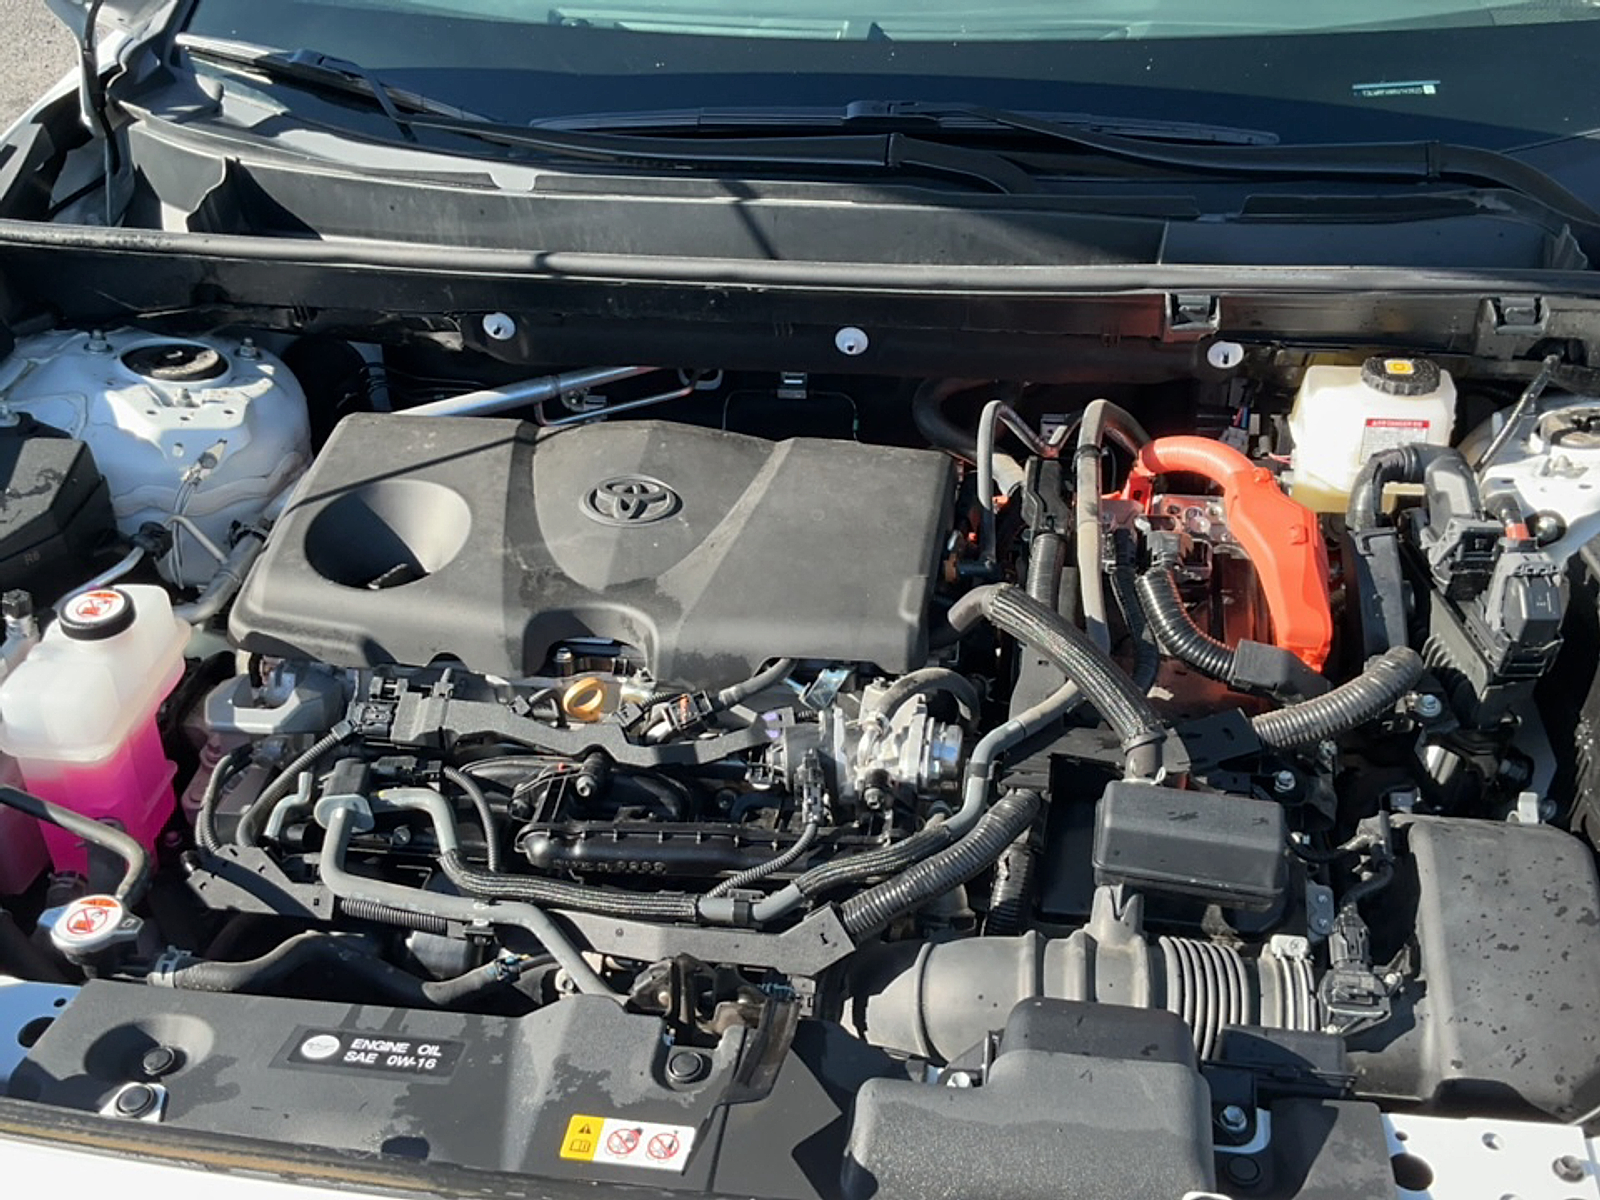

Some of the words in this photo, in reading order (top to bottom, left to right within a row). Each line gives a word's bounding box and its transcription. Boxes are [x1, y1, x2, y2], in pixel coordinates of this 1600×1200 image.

[350, 1038, 411, 1053] ENGINE
[417, 1044, 442, 1057] OIL
[343, 1050, 379, 1064] SAE
[386, 1055, 437, 1069] 0W-16
